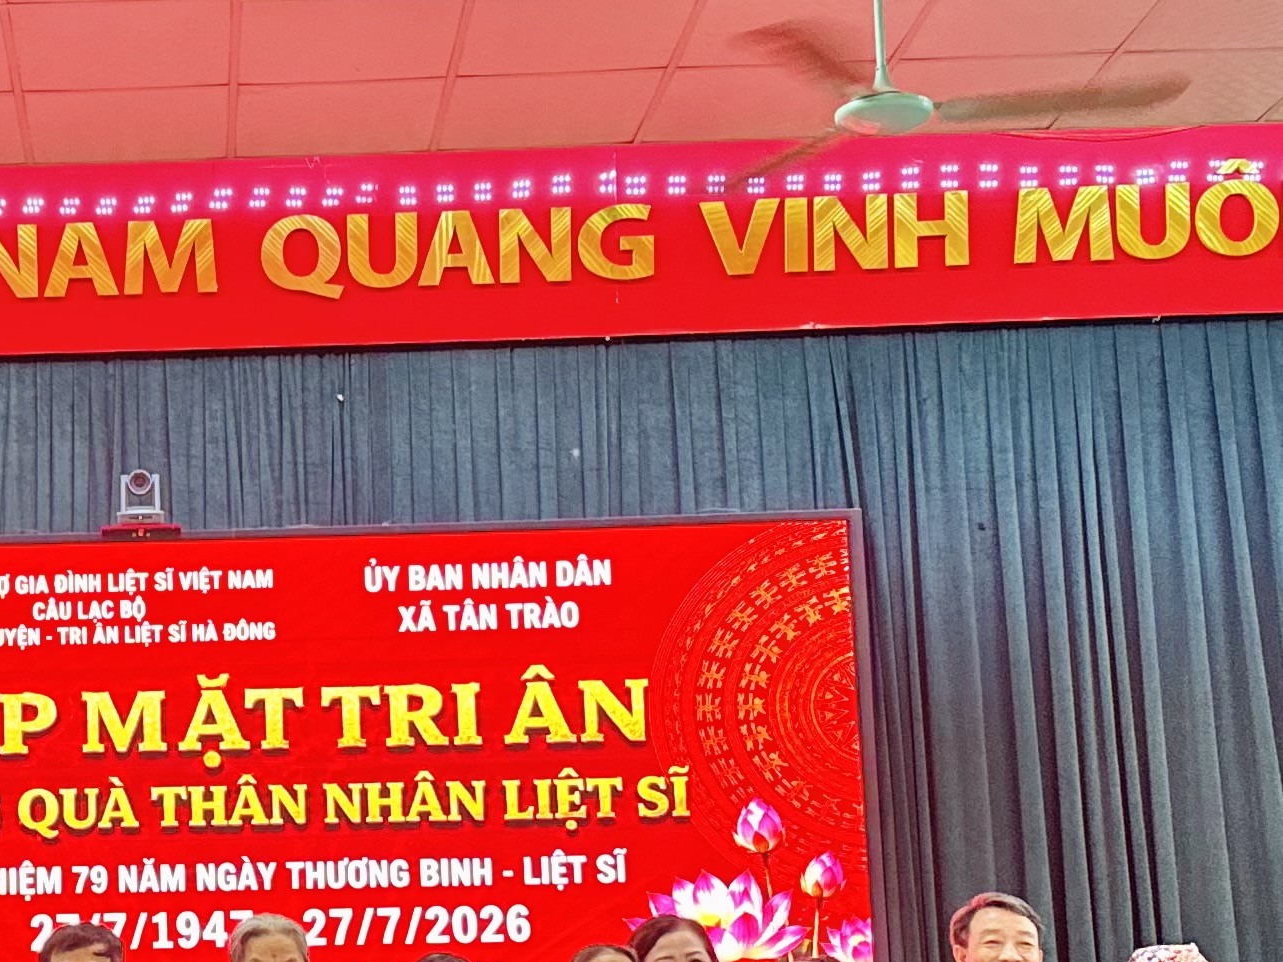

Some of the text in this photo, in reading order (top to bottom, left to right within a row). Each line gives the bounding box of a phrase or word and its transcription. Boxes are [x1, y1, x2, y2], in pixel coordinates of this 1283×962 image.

[261, 204, 654, 298] QUANG
[700, 191, 969, 275] VINH
[15, 575, 49, 594] GIA
[54, 570, 101, 593] ĐÌNH
[108, 568, 149, 598] LIỆT
[154, 568, 174, 591] SĨ
[179, 567, 222, 594] VIỆT
[228, 569, 273, 589] NAM
[365, 554, 611, 592] ỦY BAN NHÂN DÂN
[32, 596, 149, 624] CÂU LẠC BỘ
[398, 596, 579, 632] XÃ TÂN TRÀO
[57, 627, 87, 644] TRI
[93, 620, 118, 644] ÂN
[125, 620, 163, 647] LIỆT
[168, 620, 187, 642] SĨ
[192, 620, 218, 642] HÀ
[223, 618, 275, 641] ĐÔNG
[82, 673, 304, 769] MẶT
[321, 682, 482, 748] TRI
[504, 665, 648, 744] ÂN
[18, 777, 139, 838] QUÀ
[151, 774, 307, 826] THÂN
[323, 771, 485, 823] NHÂN
[502, 768, 622, 830] LIỆT
[637, 765, 690, 817] SĨ
[72, 865, 108, 893] 79
[118, 858, 185, 892] NĂM
[196, 856, 276, 891] NGÀY
[286, 857, 410, 889] THƯƠNG
[420, 858, 492, 887] BINH
[524, 849, 587, 890] LIỆT
[596, 848, 627, 883] SĨ
[30, 904, 531, 952] 27/194 27/7/2026
